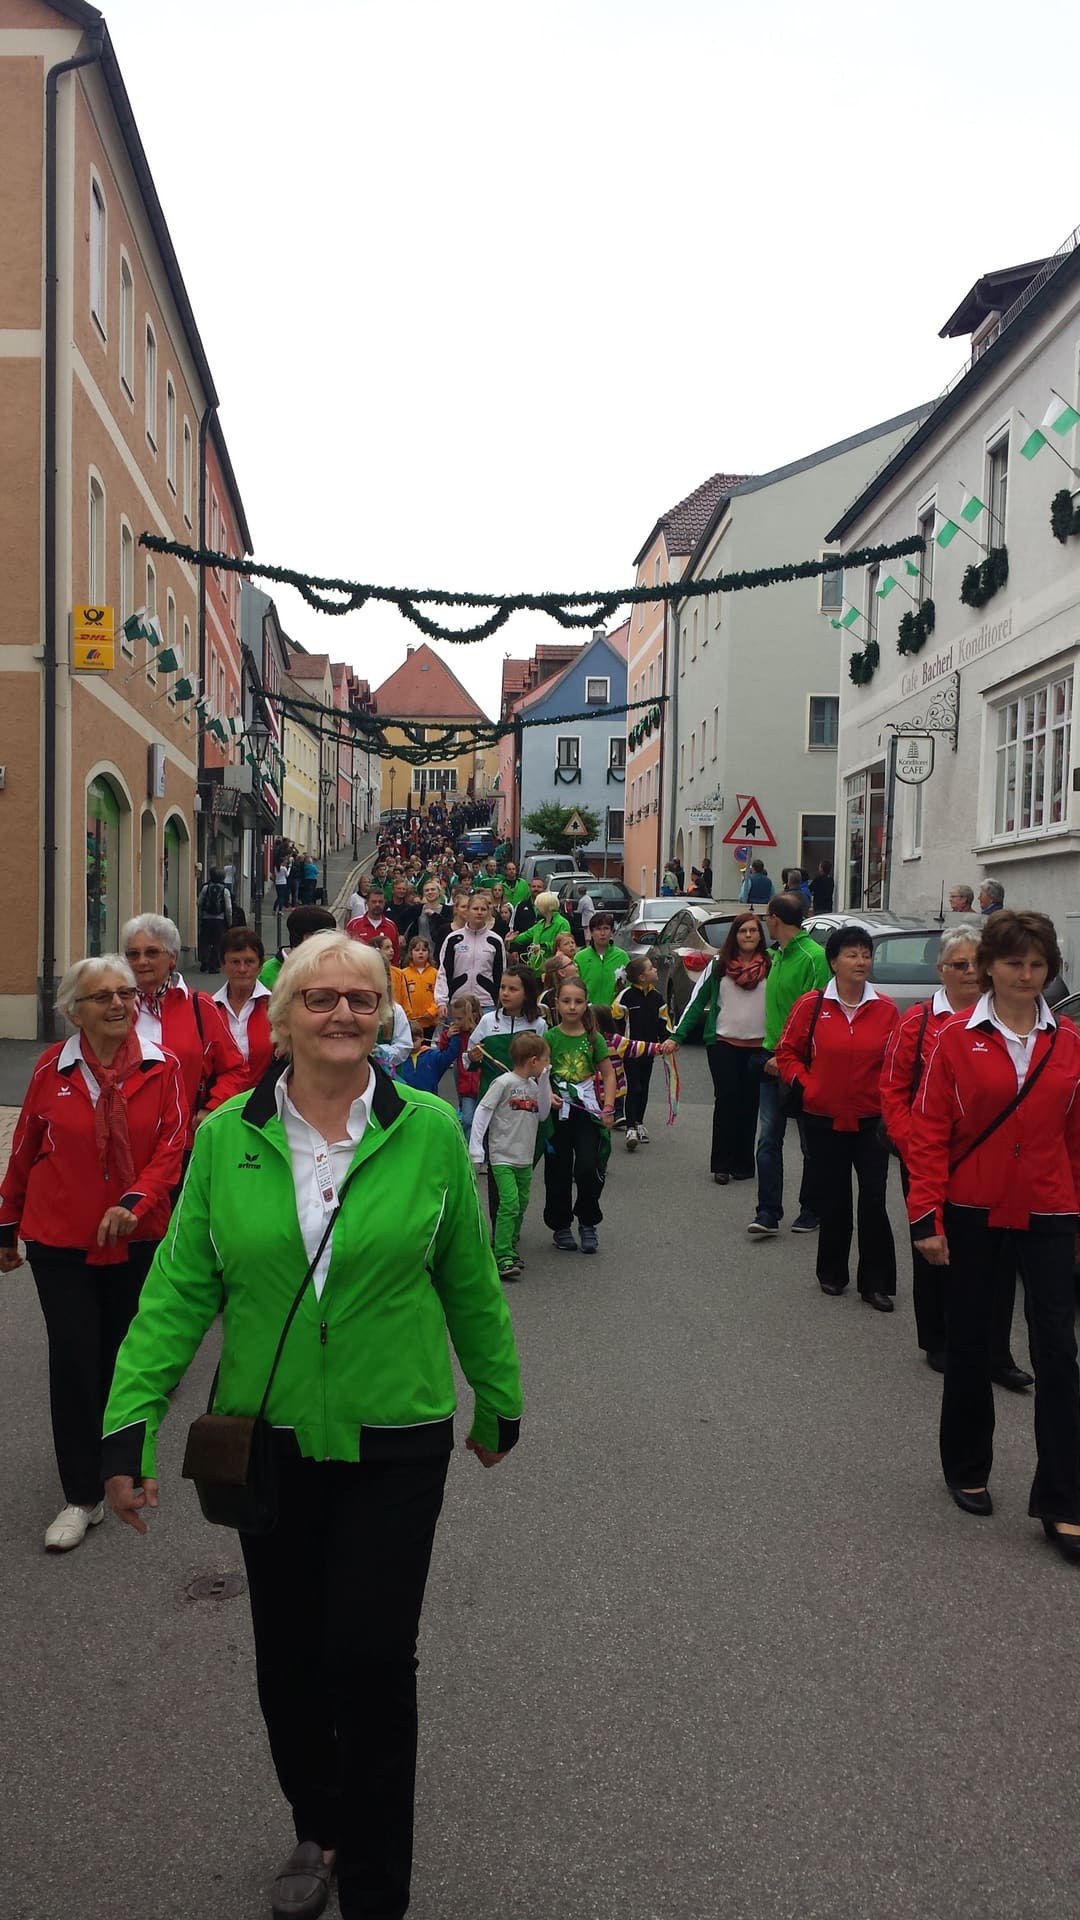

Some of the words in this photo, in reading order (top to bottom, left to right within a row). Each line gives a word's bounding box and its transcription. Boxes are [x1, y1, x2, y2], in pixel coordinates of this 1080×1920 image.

[79, 633, 108, 641] DHL
[922, 644, 954, 686] Bacherl
[958, 607, 1013, 665] Konditorei
